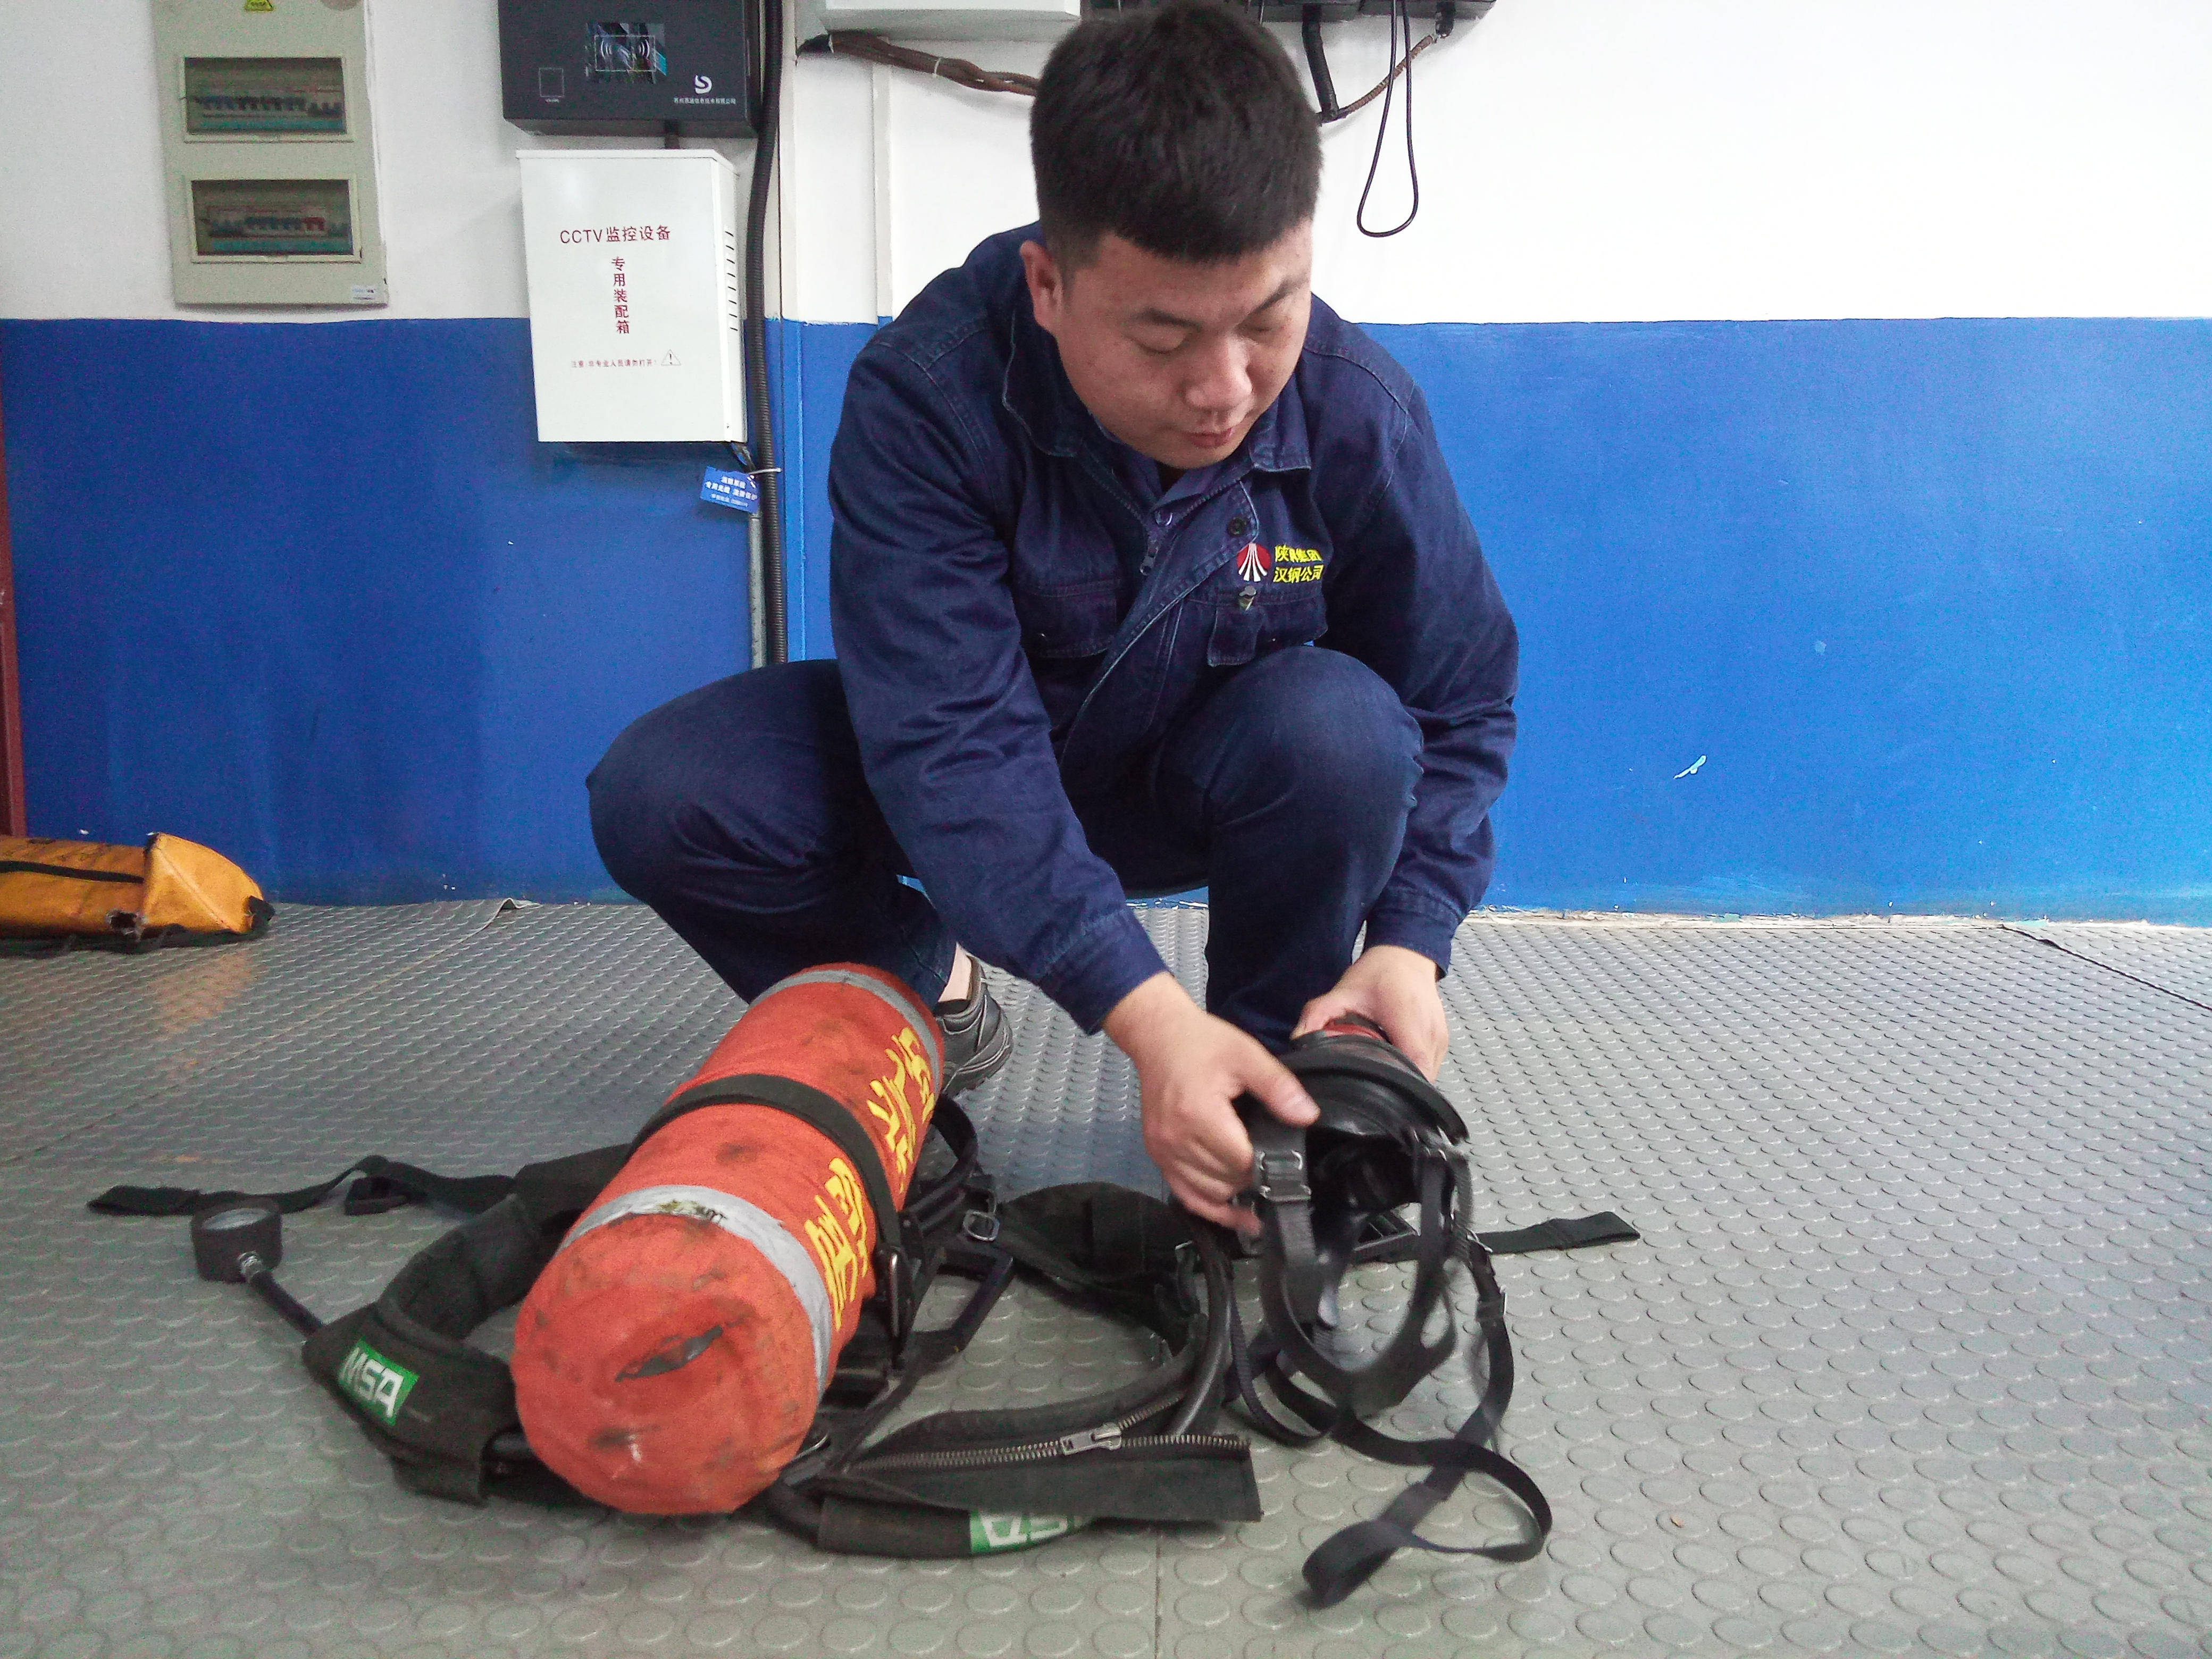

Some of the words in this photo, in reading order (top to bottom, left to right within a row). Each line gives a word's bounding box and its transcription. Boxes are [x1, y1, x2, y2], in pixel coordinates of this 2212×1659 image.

[560, 225, 671, 244] CCTV监控设备
[611, 256, 630, 334] 专用装配箱
[1273, 565, 1324, 583] 汉钢公司
